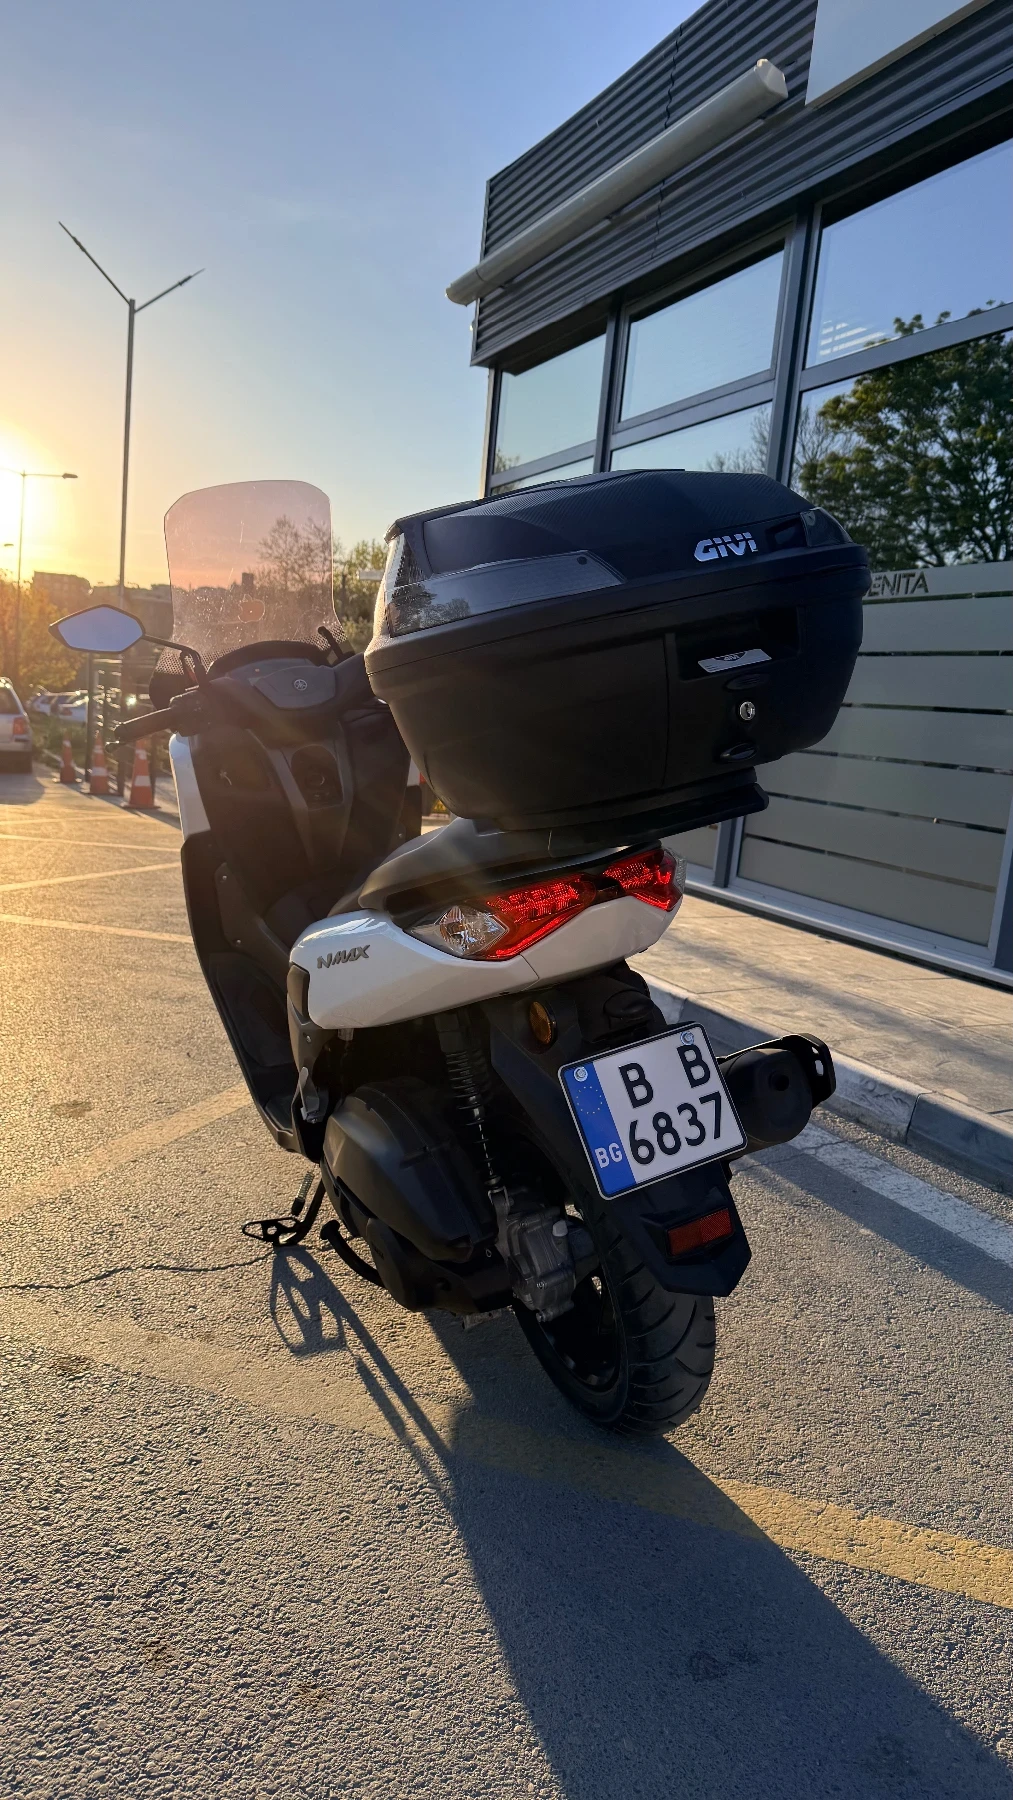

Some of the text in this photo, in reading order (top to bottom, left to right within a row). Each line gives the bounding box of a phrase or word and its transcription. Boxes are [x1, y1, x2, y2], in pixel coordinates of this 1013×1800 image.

[694, 532, 759, 562] GIVI
[316, 944, 371, 969] NMAX
[619, 1045, 711, 1109] B B
[629, 1091, 722, 1165] 6837
[595, 1143, 623, 1168] BG
